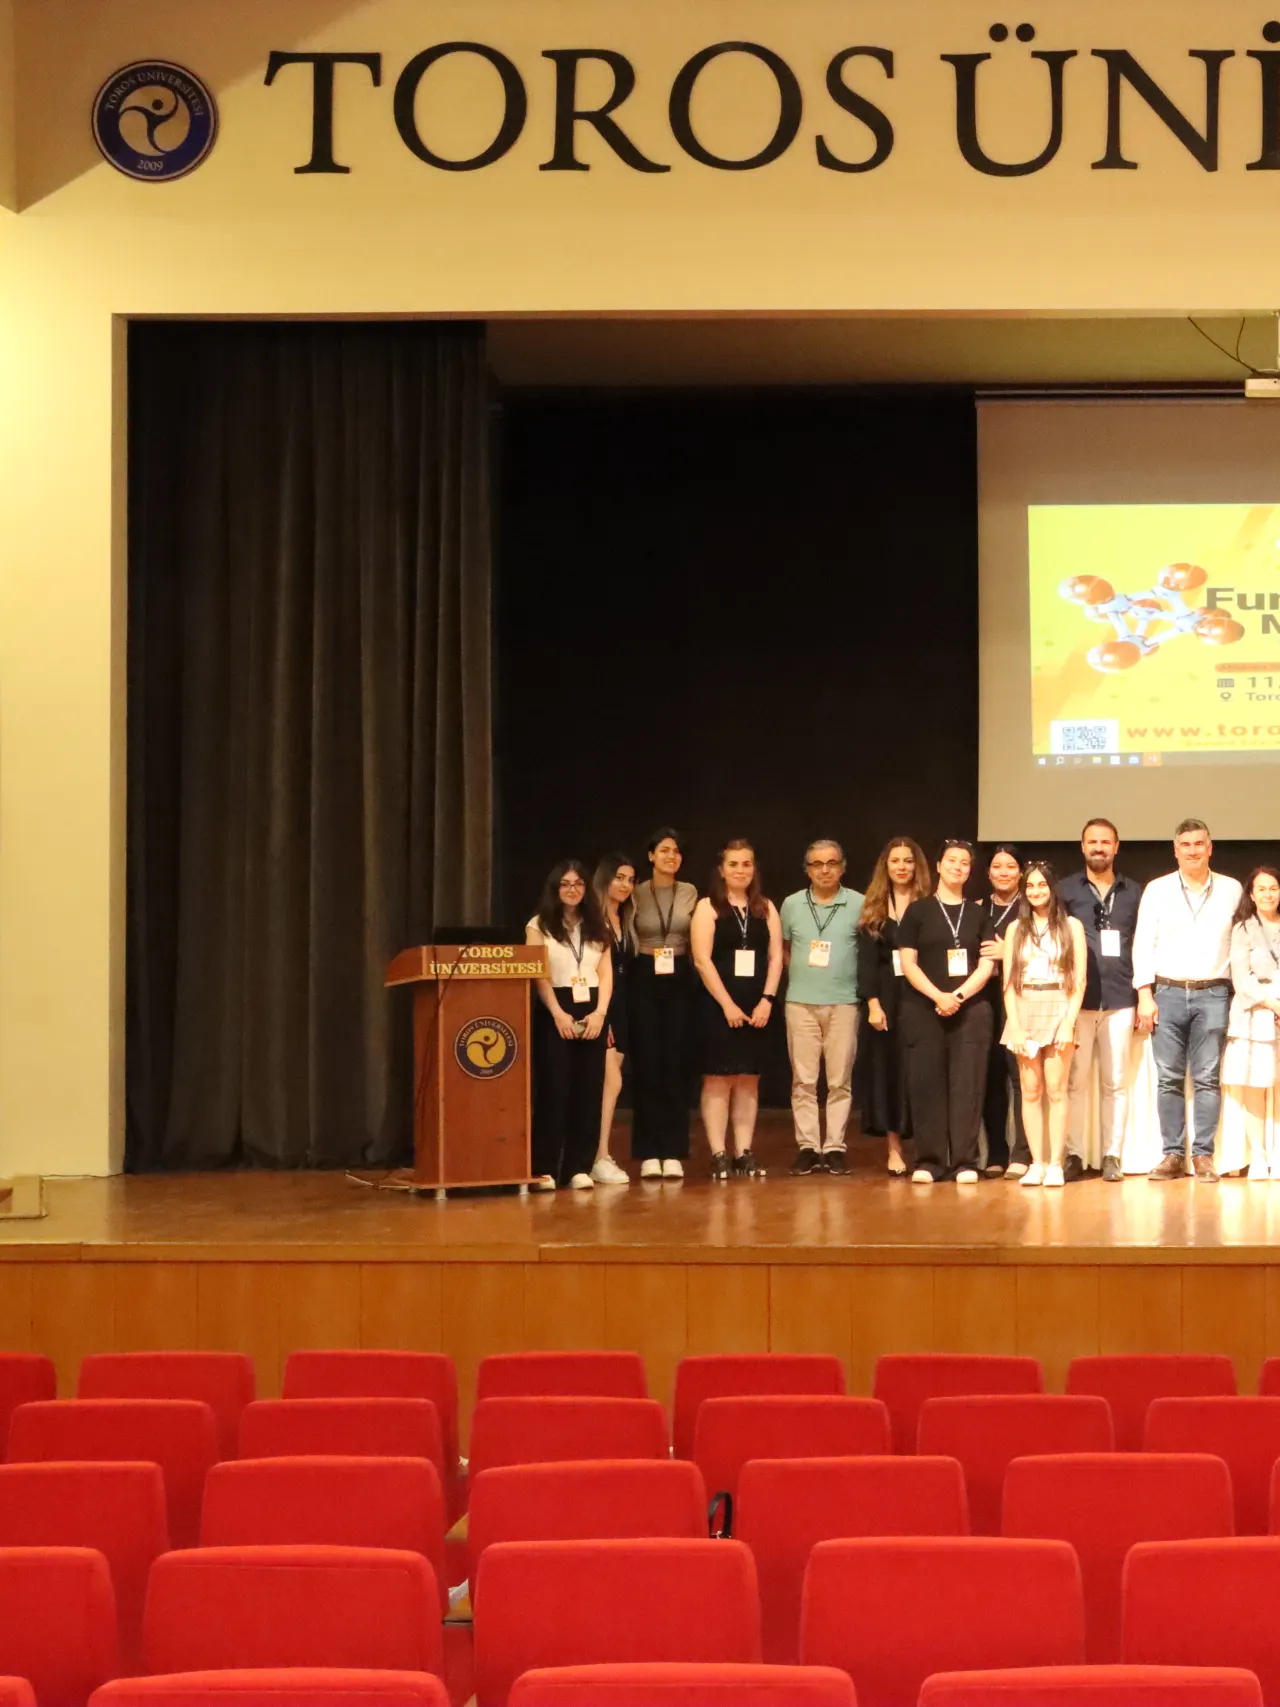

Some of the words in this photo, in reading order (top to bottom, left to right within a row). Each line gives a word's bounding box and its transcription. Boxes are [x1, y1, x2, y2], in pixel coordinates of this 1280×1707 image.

[105, 77, 137, 110] TOROS
[264, 41, 893, 173] TOROS
[137, 159, 164, 171] 2009
[459, 946, 514, 958] TOROS
